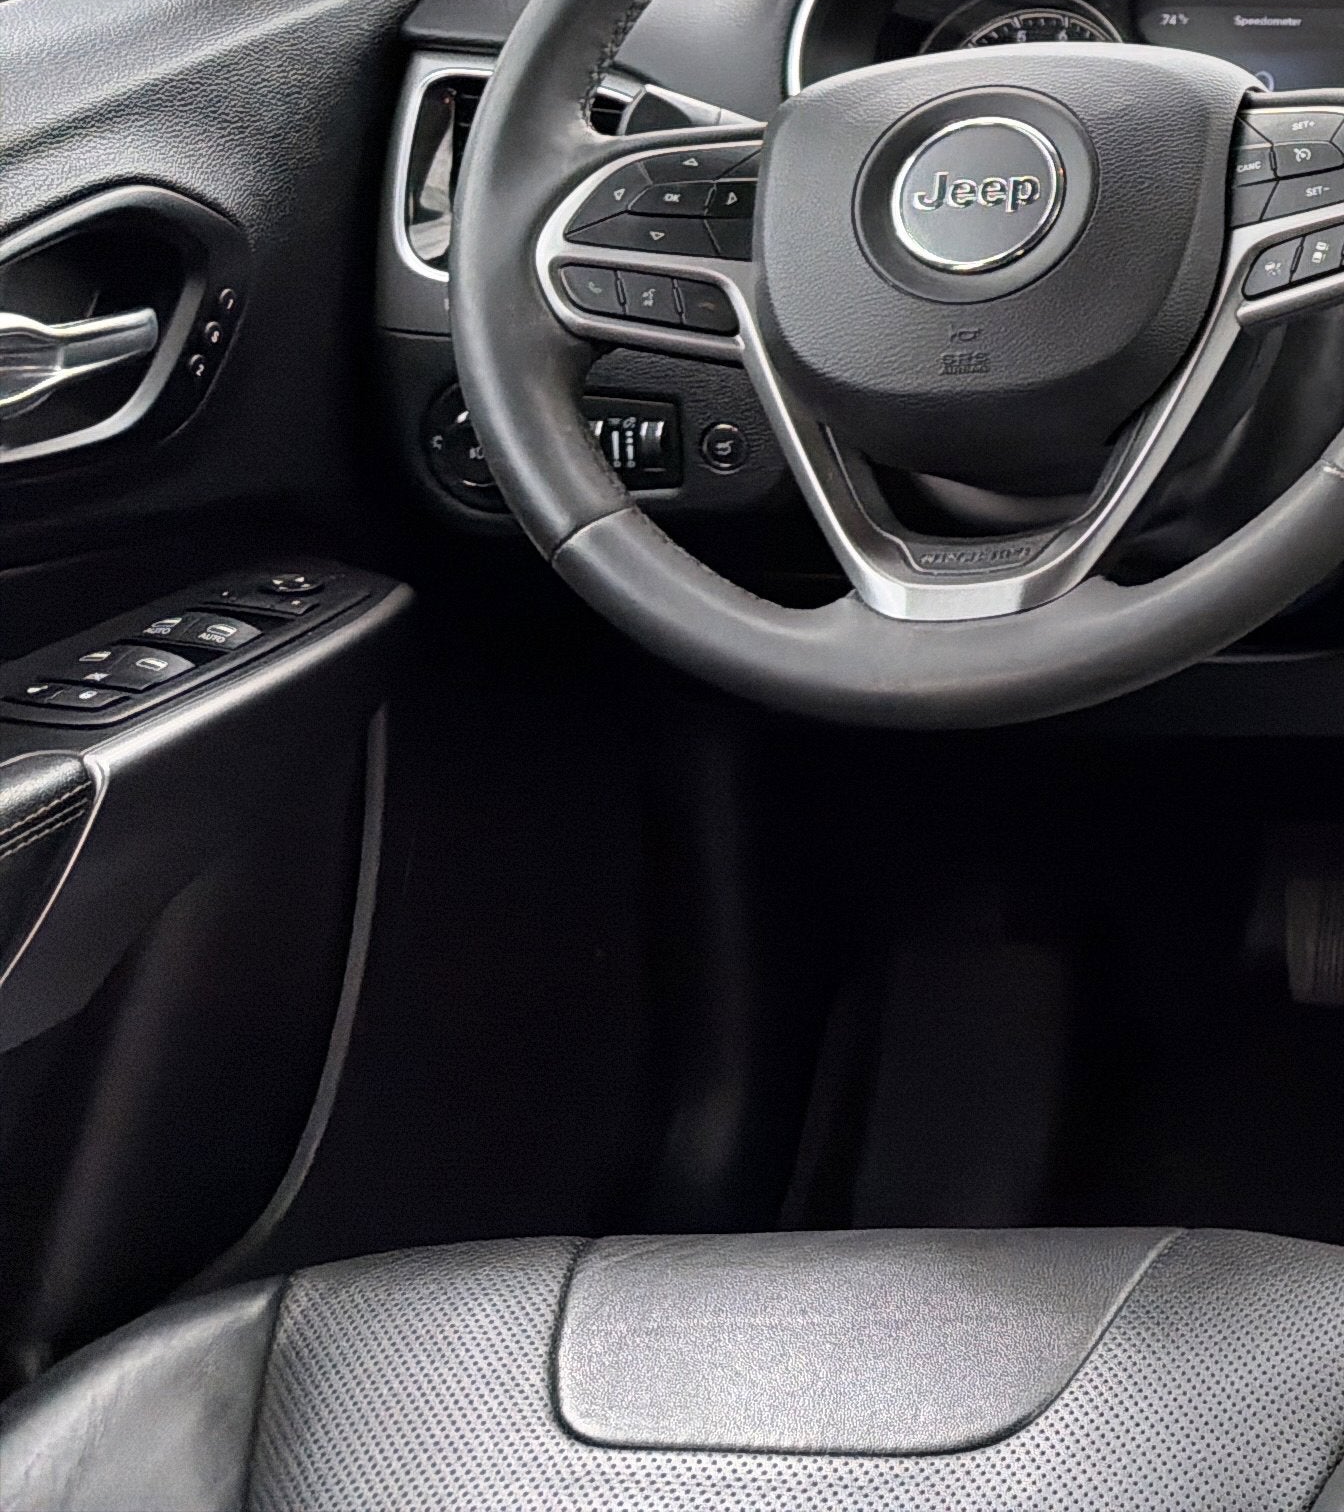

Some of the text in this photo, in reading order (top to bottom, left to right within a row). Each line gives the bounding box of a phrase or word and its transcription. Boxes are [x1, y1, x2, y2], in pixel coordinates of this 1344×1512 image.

[1233, 14, 1302, 27] Speedometer
[1236, 160, 1262, 173] CANC
[663, 193, 681, 203] OK
[912, 171, 1041, 213] Jeep
[227, 298, 234, 309] 1
[196, 363, 205, 376] 2
[198, 633, 226, 644] AUTO
